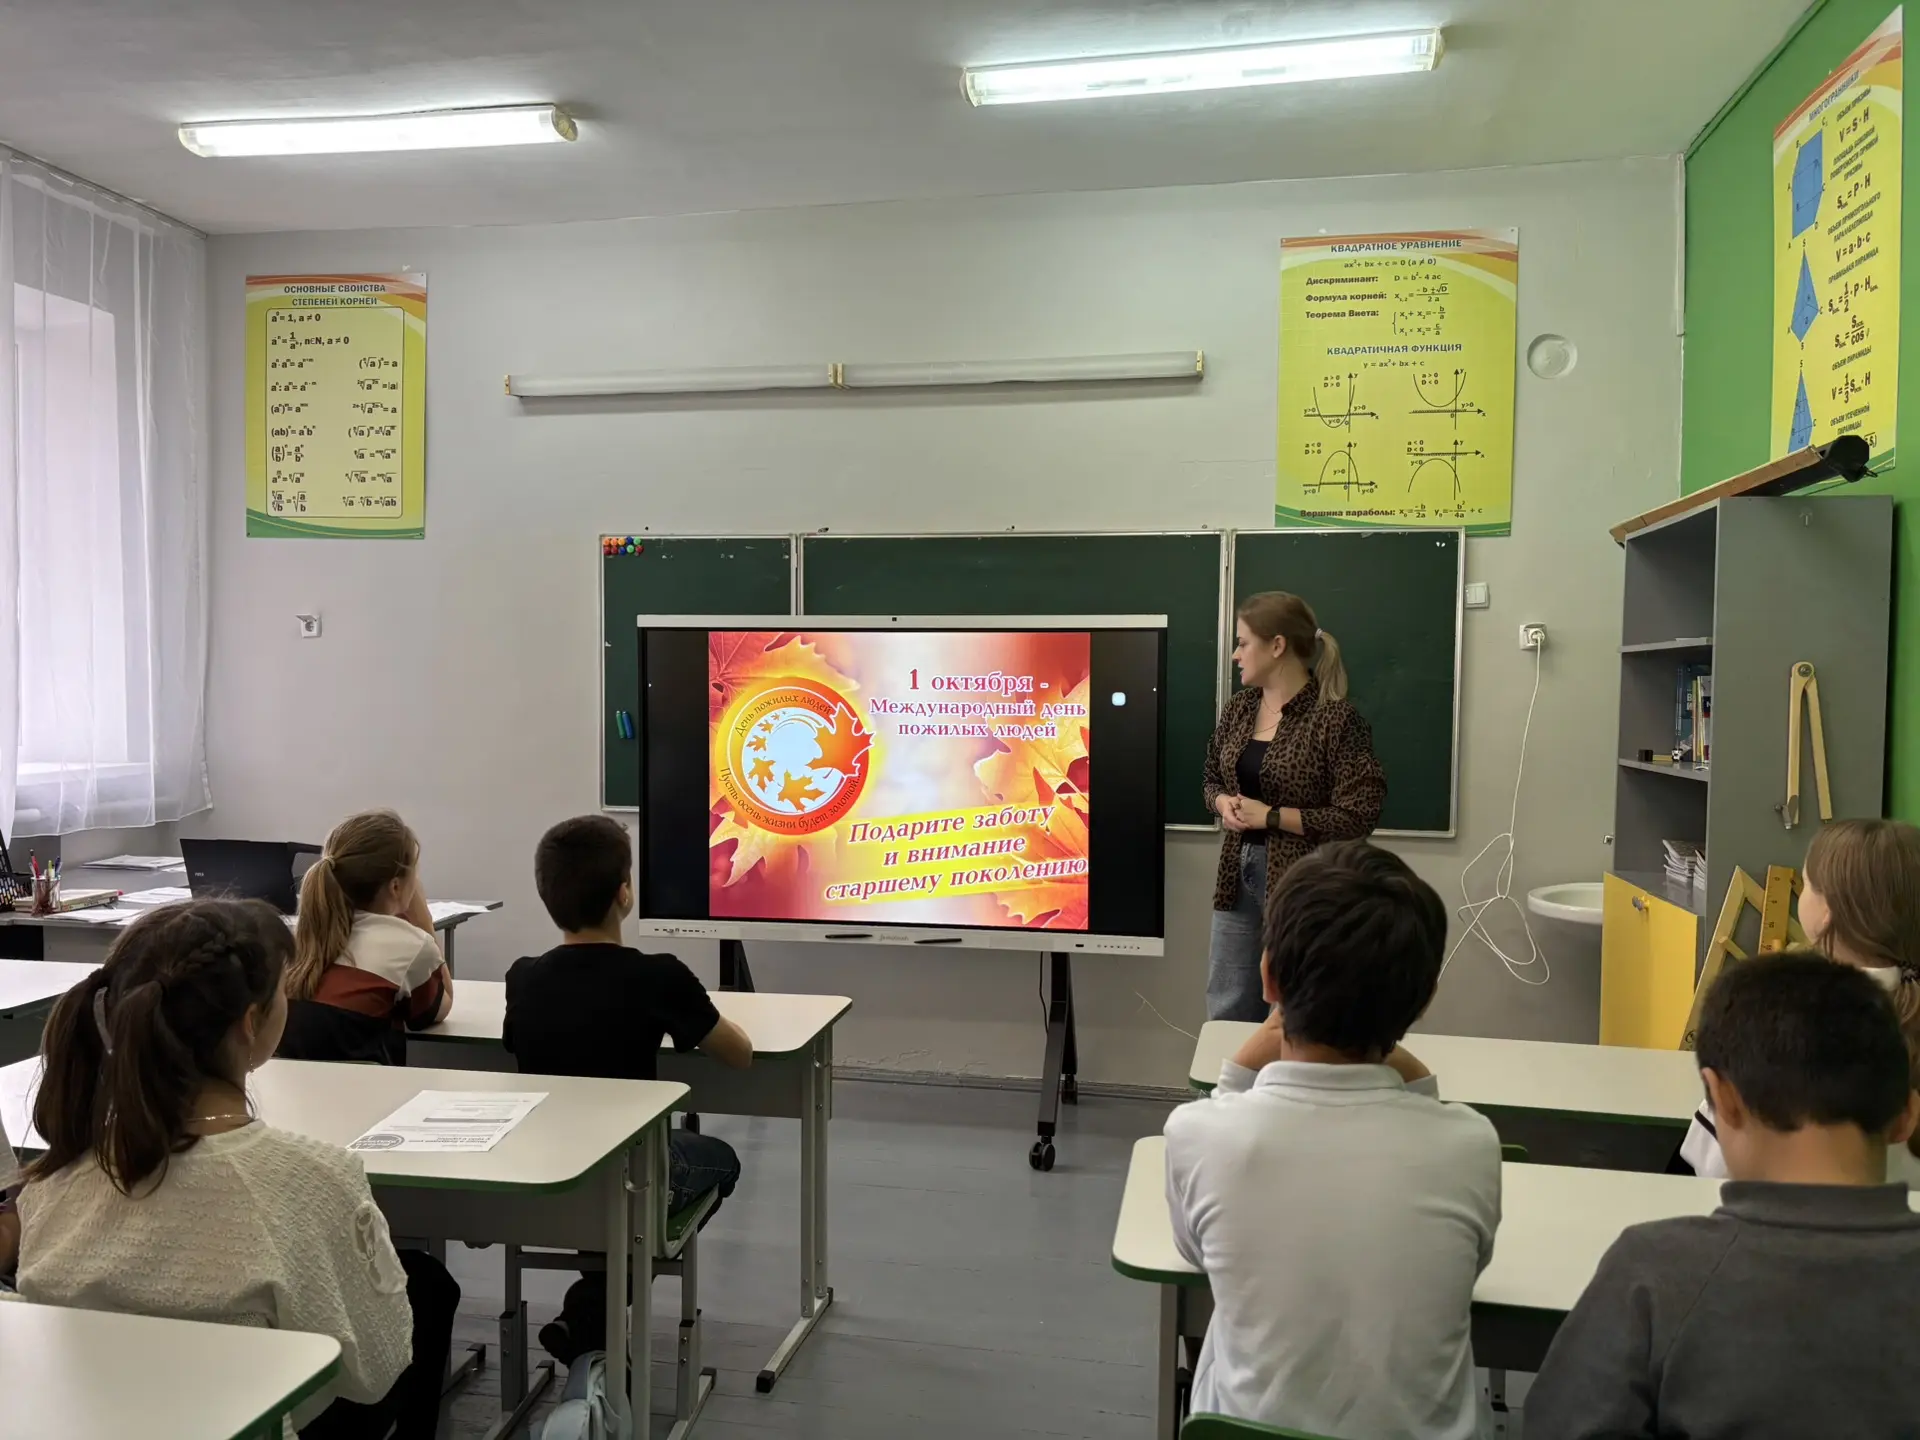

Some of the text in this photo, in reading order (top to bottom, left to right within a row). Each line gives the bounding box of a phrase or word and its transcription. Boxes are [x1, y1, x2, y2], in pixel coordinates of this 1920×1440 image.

[1331, 239, 1462, 253] КВАДРАТНОЕ УРАВНЕНИЕ
[1306, 275, 1378, 286] Дискриминант:
[284, 284, 386, 293] ОСНОВНЫЕ СВОЙСТВА
[292, 297, 378, 306] СТЕПЕНЕЙ КОРНЕЙ
[1305, 291, 1387, 303] Формула корней:
[1306, 309, 1379, 320] Теорема Виета:
[1327, 343, 1462, 356] КВАДРАТИЧНАЯ ФУНКЦИЯ
[1300, 507, 1395, 518] Вершина параболы:
[909, 669, 920, 690] 1
[931, 672, 1033, 695] октября
[755, 694, 799, 714] пожилых
[800, 696, 832, 715] людей
[870, 698, 1086, 718] Международный день
[899, 723, 1056, 740] пожилых людей
[720, 767, 739, 800] Пусть
[738, 799, 762, 821] осень
[762, 816, 796, 829] жизни
[798, 814, 828, 831] будет
[849, 805, 1055, 844] Подарите заботу
[883, 836, 1026, 866] и внимание
[825, 858, 1087, 900] старшему поколению
